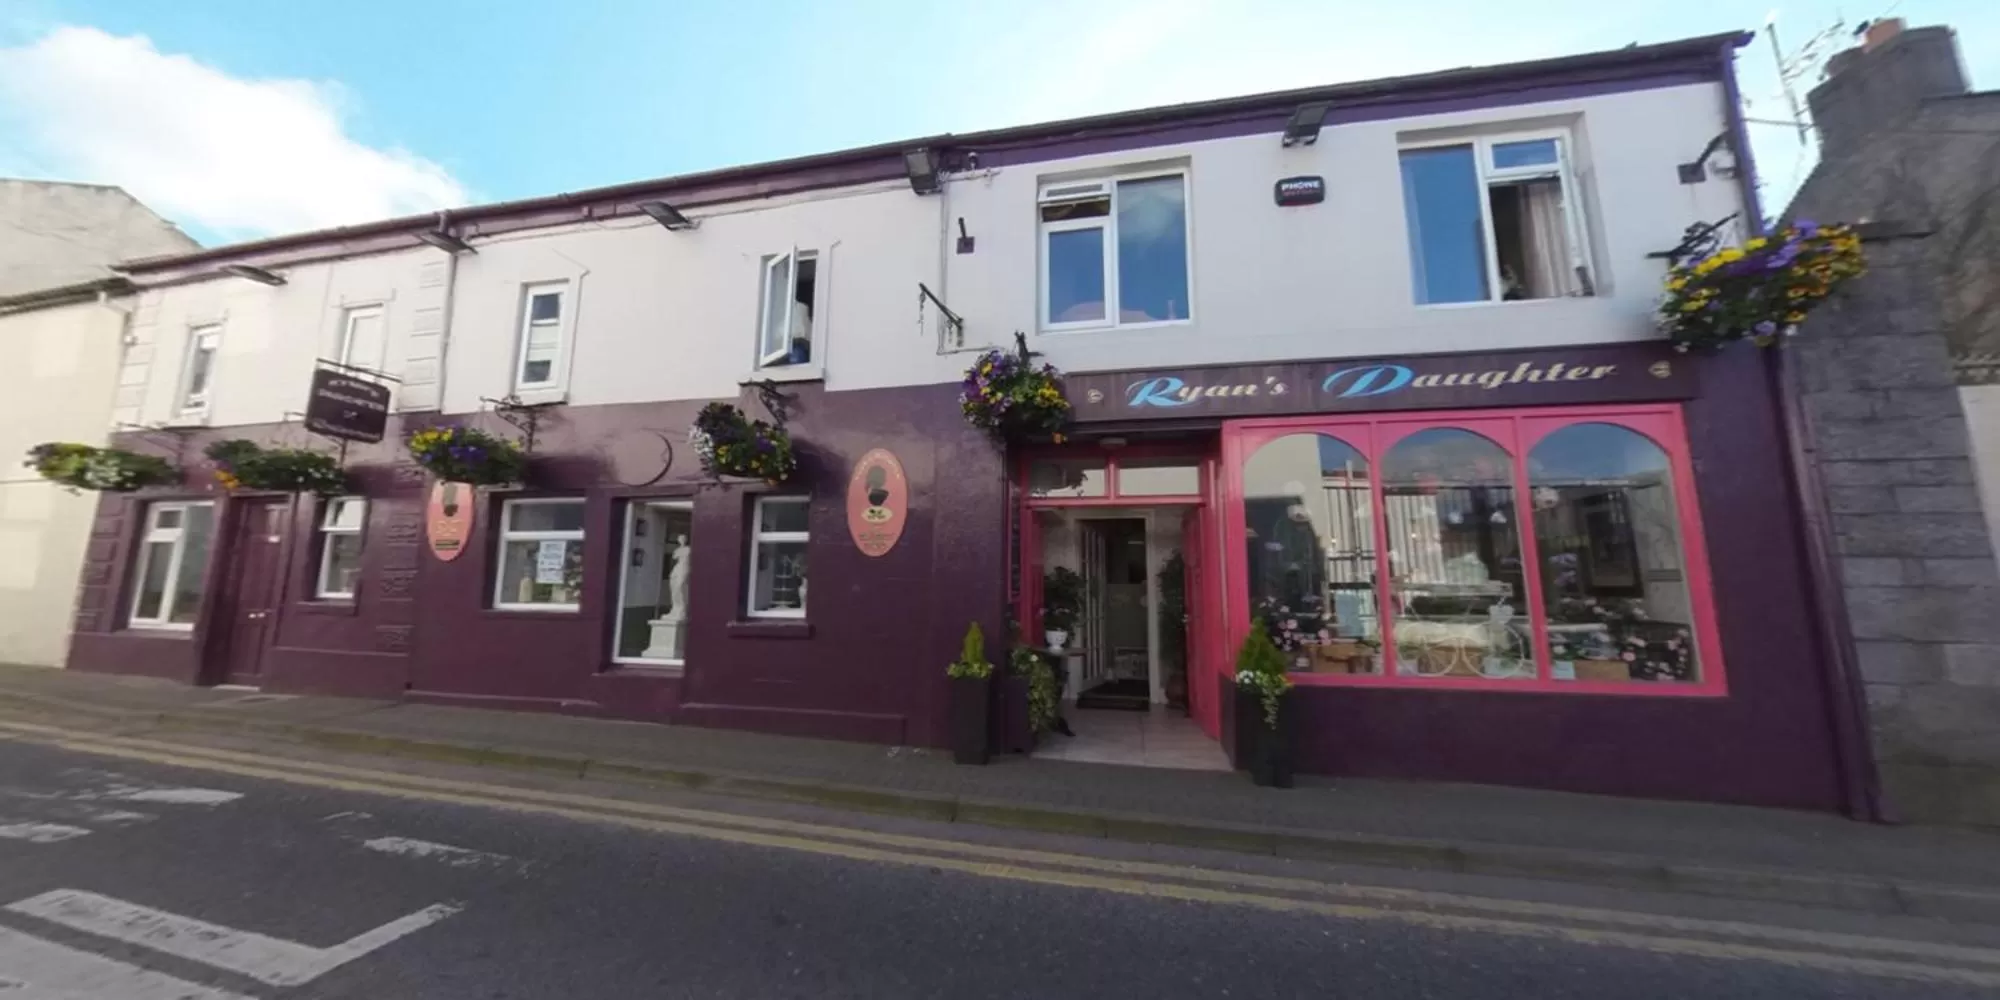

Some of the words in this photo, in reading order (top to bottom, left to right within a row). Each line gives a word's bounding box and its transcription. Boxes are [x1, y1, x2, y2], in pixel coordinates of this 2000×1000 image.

[1281, 180, 1320, 191] PHONE
[1124, 376, 1289, 408] Ryan's
[1322, 361, 1618, 399] Daughter
